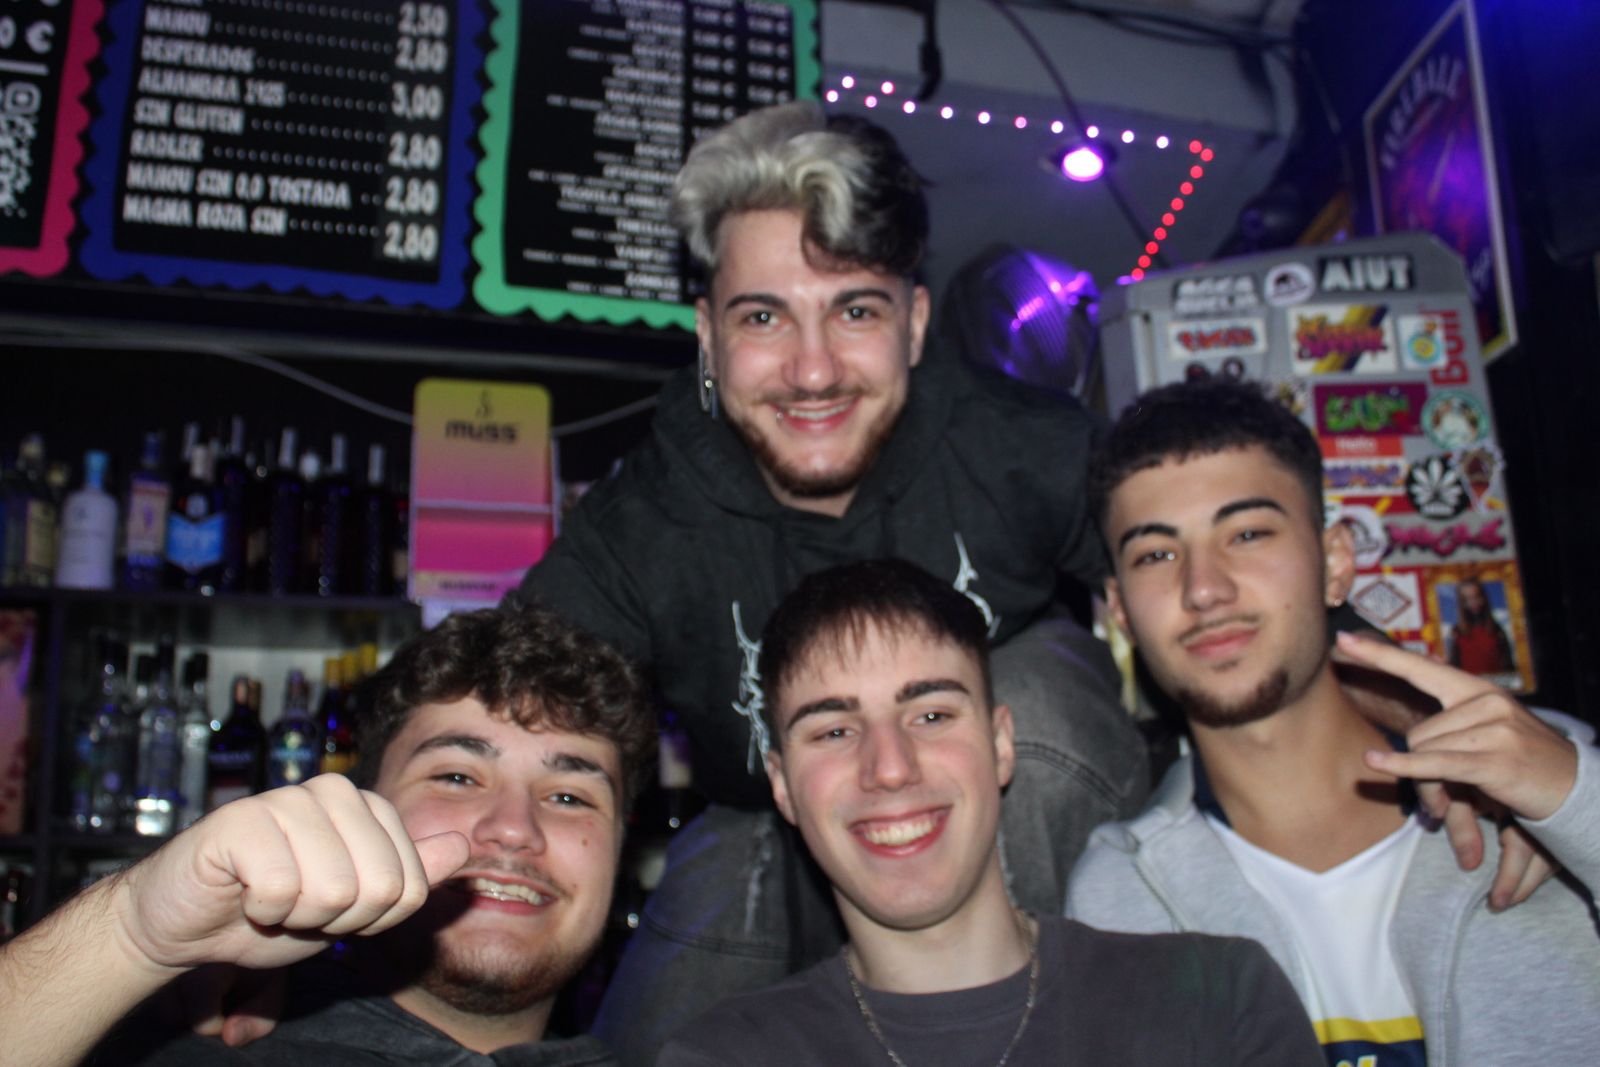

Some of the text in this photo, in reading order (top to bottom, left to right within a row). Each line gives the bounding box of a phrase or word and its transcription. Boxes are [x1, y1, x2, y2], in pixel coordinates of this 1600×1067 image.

[145, 5, 209, 36] MAHOU
[142, 35, 254, 72] DESPERADOS
[138, 67, 238, 101] ALHAMBRA
[392, 82, 442, 120] 3,00
[134, 98, 440, 170] SIN GLUTEN 2,80
[127, 161, 193, 193] MAHOU
[196, 168, 233, 197] SIN
[268, 175, 351, 209] TOSTADA
[130, 129, 438, 216] RADLER 2,80
[251, 206, 287, 236] SIN
[383, 221, 436, 261] 2,80
[445, 420, 519, 444] muss
